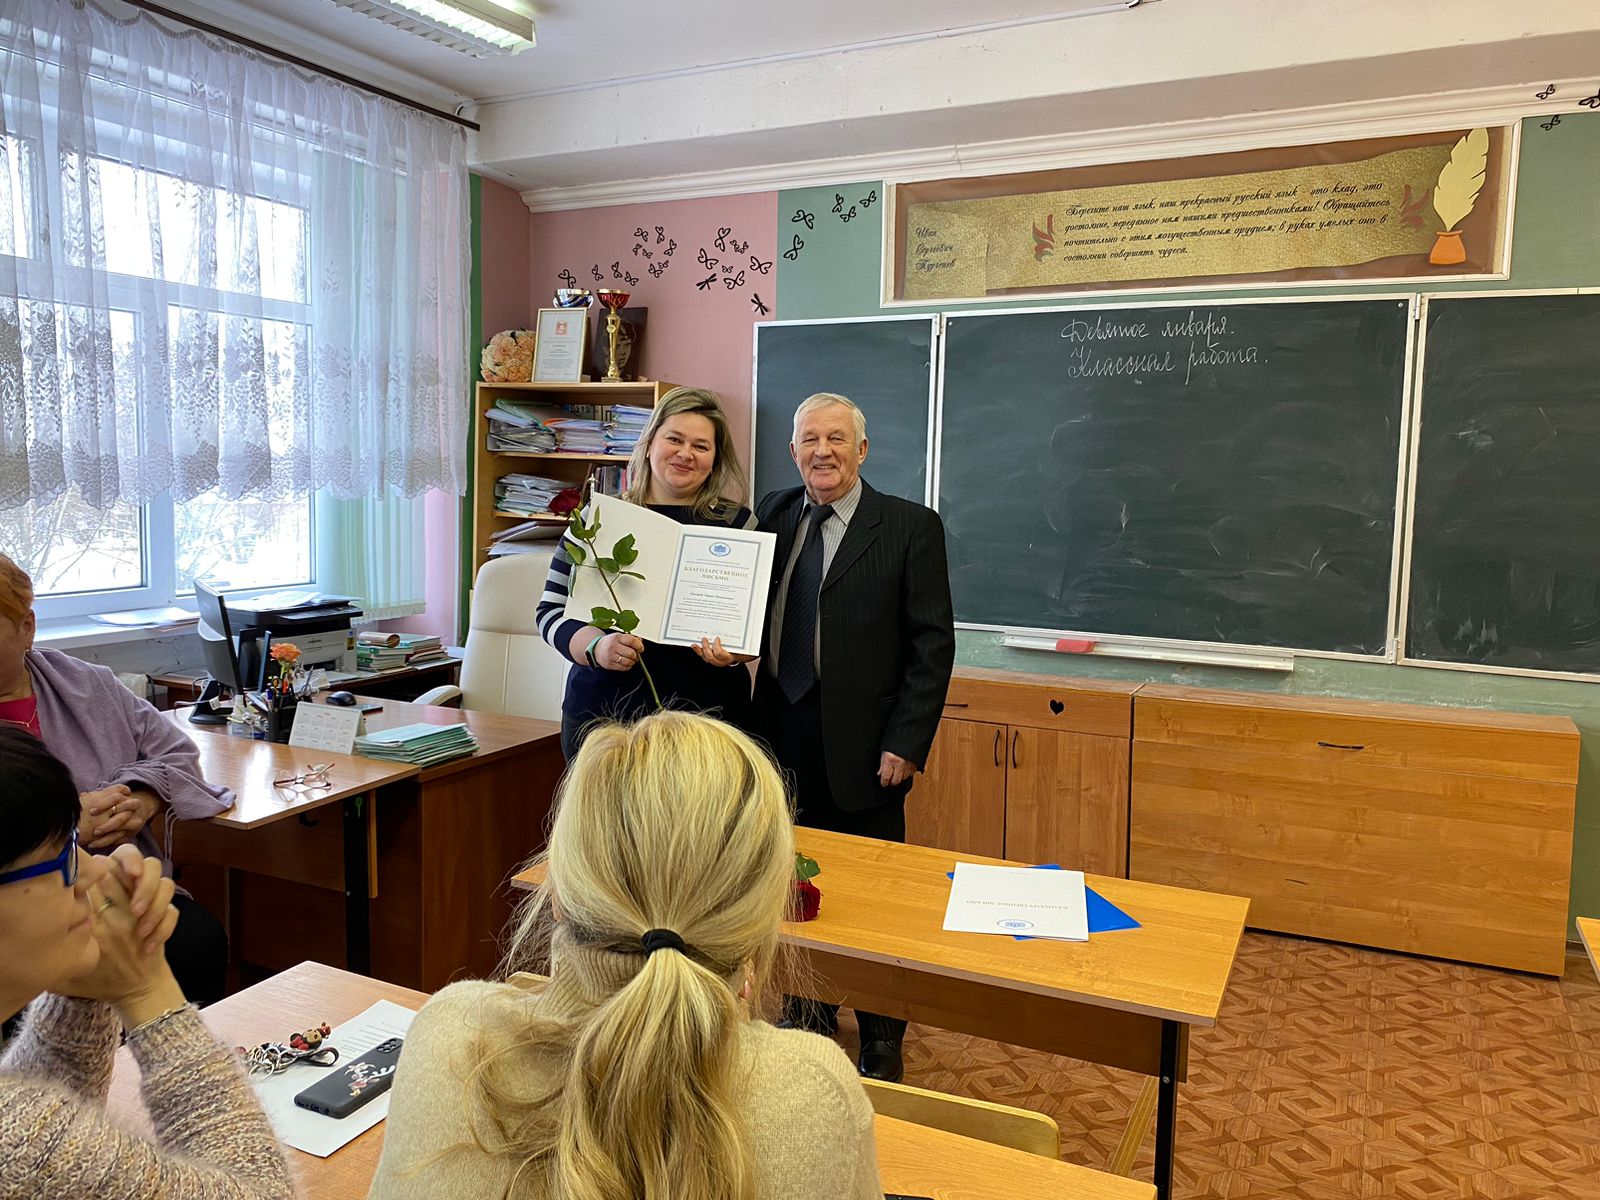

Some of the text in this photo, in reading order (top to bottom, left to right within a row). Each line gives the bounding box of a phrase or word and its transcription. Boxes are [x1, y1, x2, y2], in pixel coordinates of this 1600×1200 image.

[1064, 198, 1391, 234] достояние, переданное нам нашими предшественниками! Обращайтесь
[1066, 181, 1383, 218] Берегите наш язык, наш прекрасный русский язык это клад, это
[1063, 213, 1388, 247] почтительно с этим могущественным орудием; в руках умелых оно в
[1063, 245, 1188, 262] состоянии совершать чудеса.
[1060, 310, 1235, 348] Девятое января.
[1068, 341, 1269, 385] Классная работа.
[684, 566, 748, 577] БЛАГОДАРСТВЕННОЕ
[701, 573, 729, 581] ПИСЬМО
